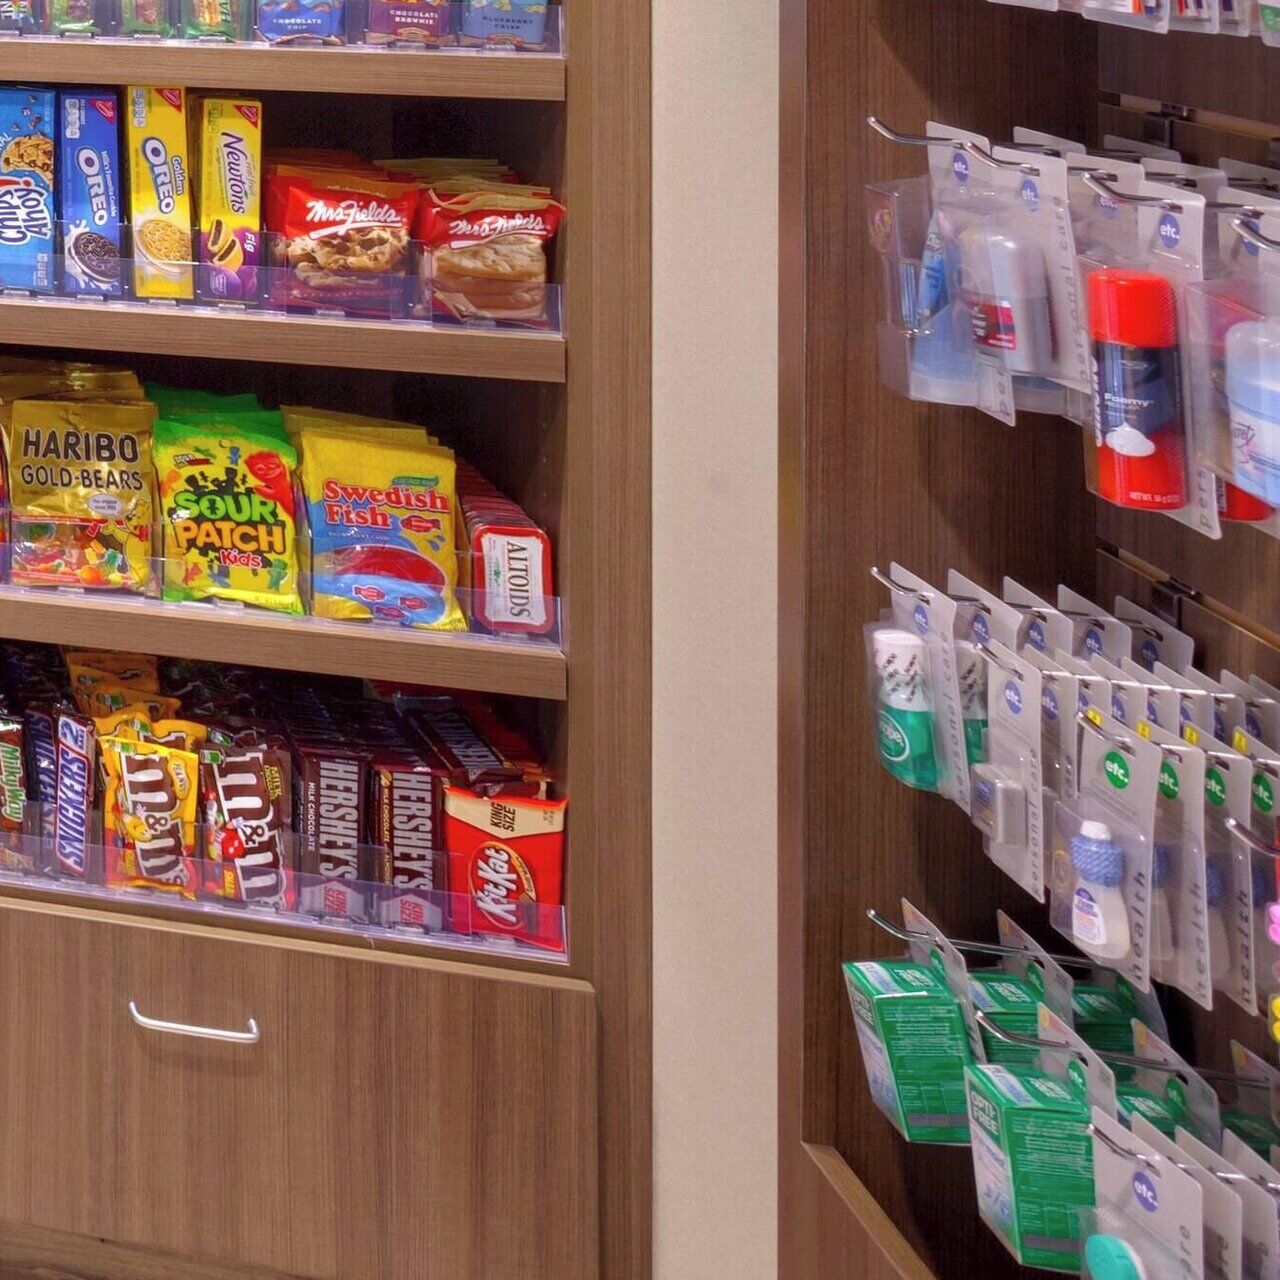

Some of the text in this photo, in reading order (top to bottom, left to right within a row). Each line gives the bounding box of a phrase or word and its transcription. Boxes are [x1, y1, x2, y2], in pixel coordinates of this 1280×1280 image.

[76, 147, 107, 226] OREO
[141, 136, 175, 214] OREO
[170, 155, 185, 195] Golden
[220, 132, 246, 214] Newtons
[244, 232, 255, 253] Fig
[1160, 223, 1180, 239] etc.
[1104, 392, 1150, 408] Foamy
[23, 428, 138, 463] HARIBO
[21, 464, 143, 491] GOLD-BEARS
[174, 492, 279, 522] SOUR
[323, 479, 449, 512] Swedish
[325, 502, 391, 528] Fish
[176, 521, 285, 555] PATCH
[219, 549, 262, 567] Kids
[505, 540, 530, 619] ALTOIDS
[271, 766, 283, 797] MILK
[1105, 759, 1129, 783] etc.
[2, 786, 26, 821] Way
[58, 747, 87, 870] SNICKERS
[307, 782, 316, 852] MILK CHOCOLATE
[319, 759, 359, 881] HERSHEY'S
[490, 801, 504, 828] KING
[503, 804, 515, 832] SIZE
[393, 771, 432, 891] HERSHEY'S
